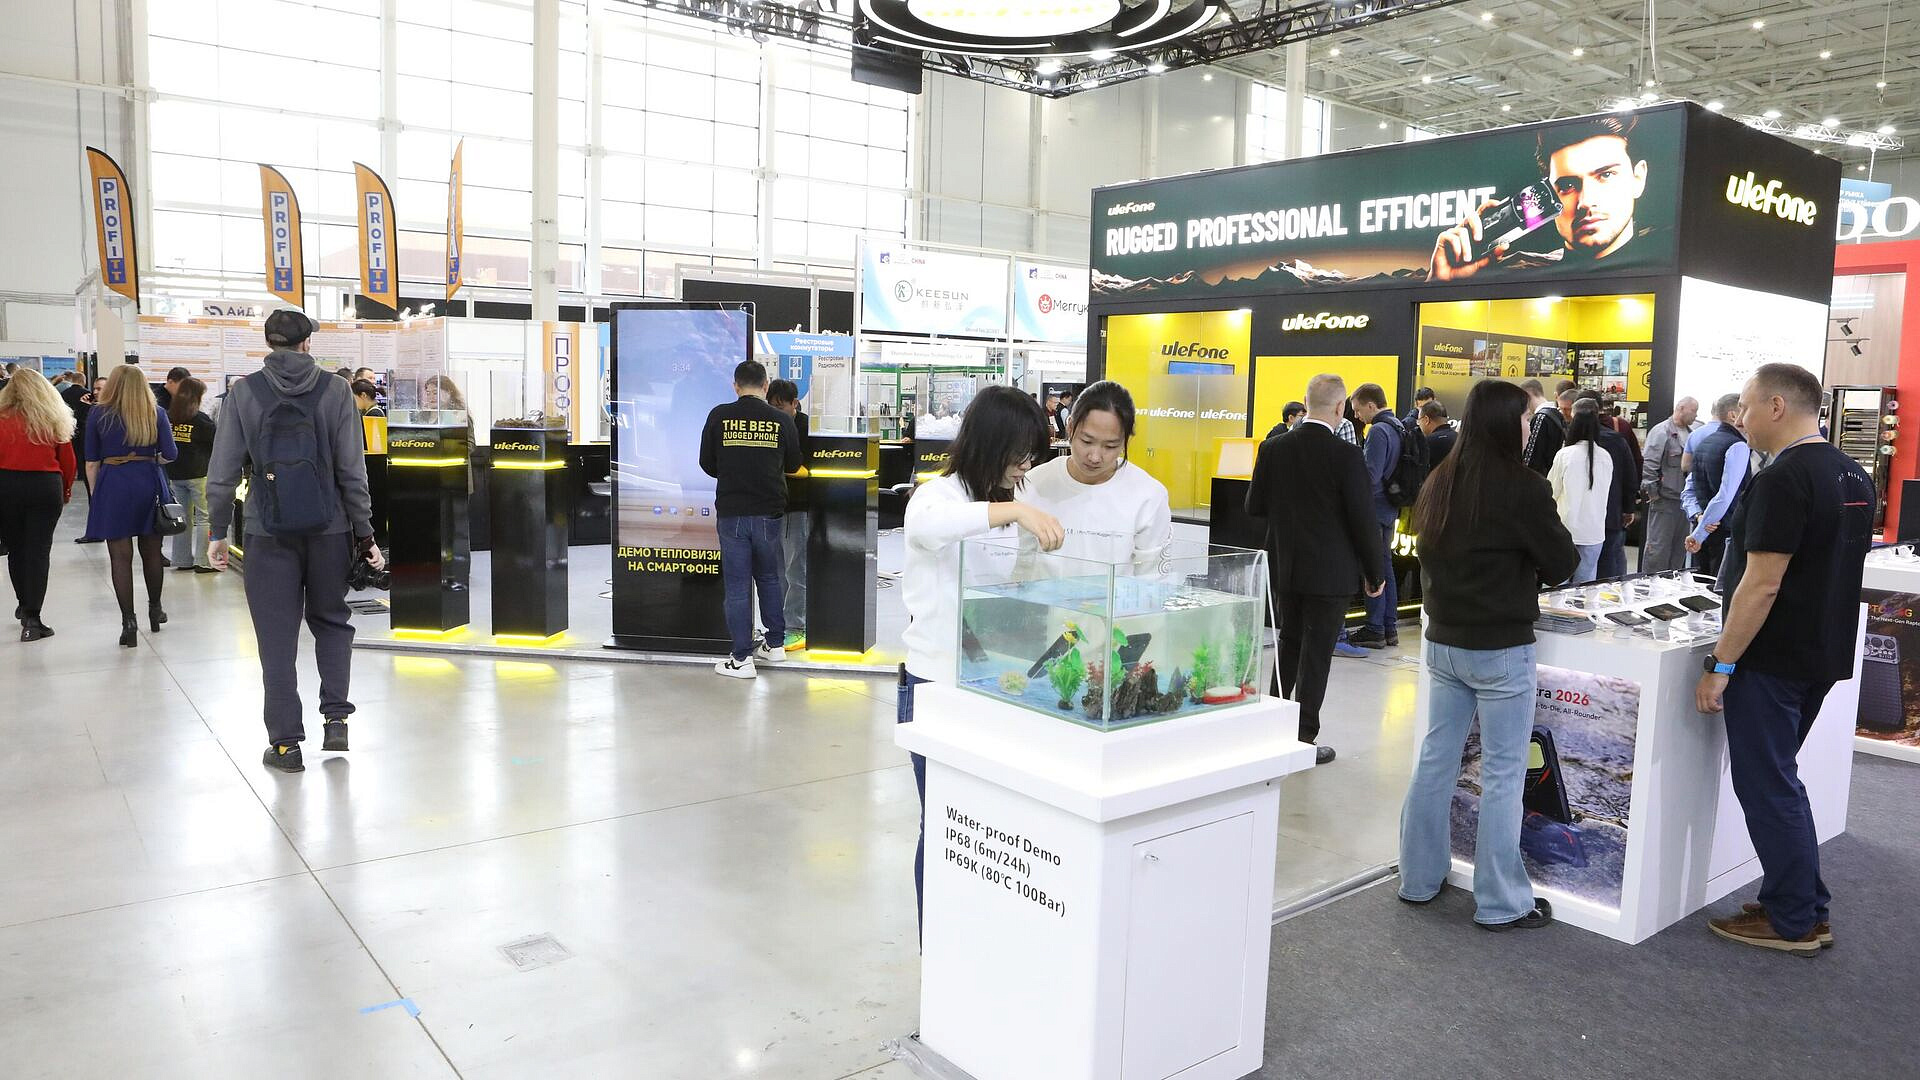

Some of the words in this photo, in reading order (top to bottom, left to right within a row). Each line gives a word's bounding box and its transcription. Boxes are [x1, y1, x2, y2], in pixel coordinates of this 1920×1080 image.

[1106, 221, 1177, 256] RUGGED
[1186, 203, 1348, 249] PROFESSIONAL
[1359, 186, 1496, 234] EFFICIENT
[103, 181, 122, 281] PROFITT
[274, 195, 290, 289] PROFITT
[369, 196, 384, 290] PROFITT
[916, 288, 969, 301] KEESUN
[722, 419, 747, 431] THE
[749, 420, 781, 433] BEST
[723, 431, 753, 440] RUGGED
[753, 432, 779, 441] PHONE
[920, 452, 950, 462] uleF
[617, 546, 651, 558] ДЕМО
[628, 561, 645, 572] НА
[647, 562, 719, 575] СМАРТФОНЕ
[1556, 689, 1590, 706] 2026
[1562, 707, 1601, 721] All-Rounder
[946, 805, 1019, 848] Water-proof
[1023, 838, 1061, 866] Demo
[946, 826, 971, 849] IP68
[974, 840, 1031, 879] (6m/24h)
[945, 847, 978, 874] IP69K
[1016, 880, 1066, 918] 100Bar)
